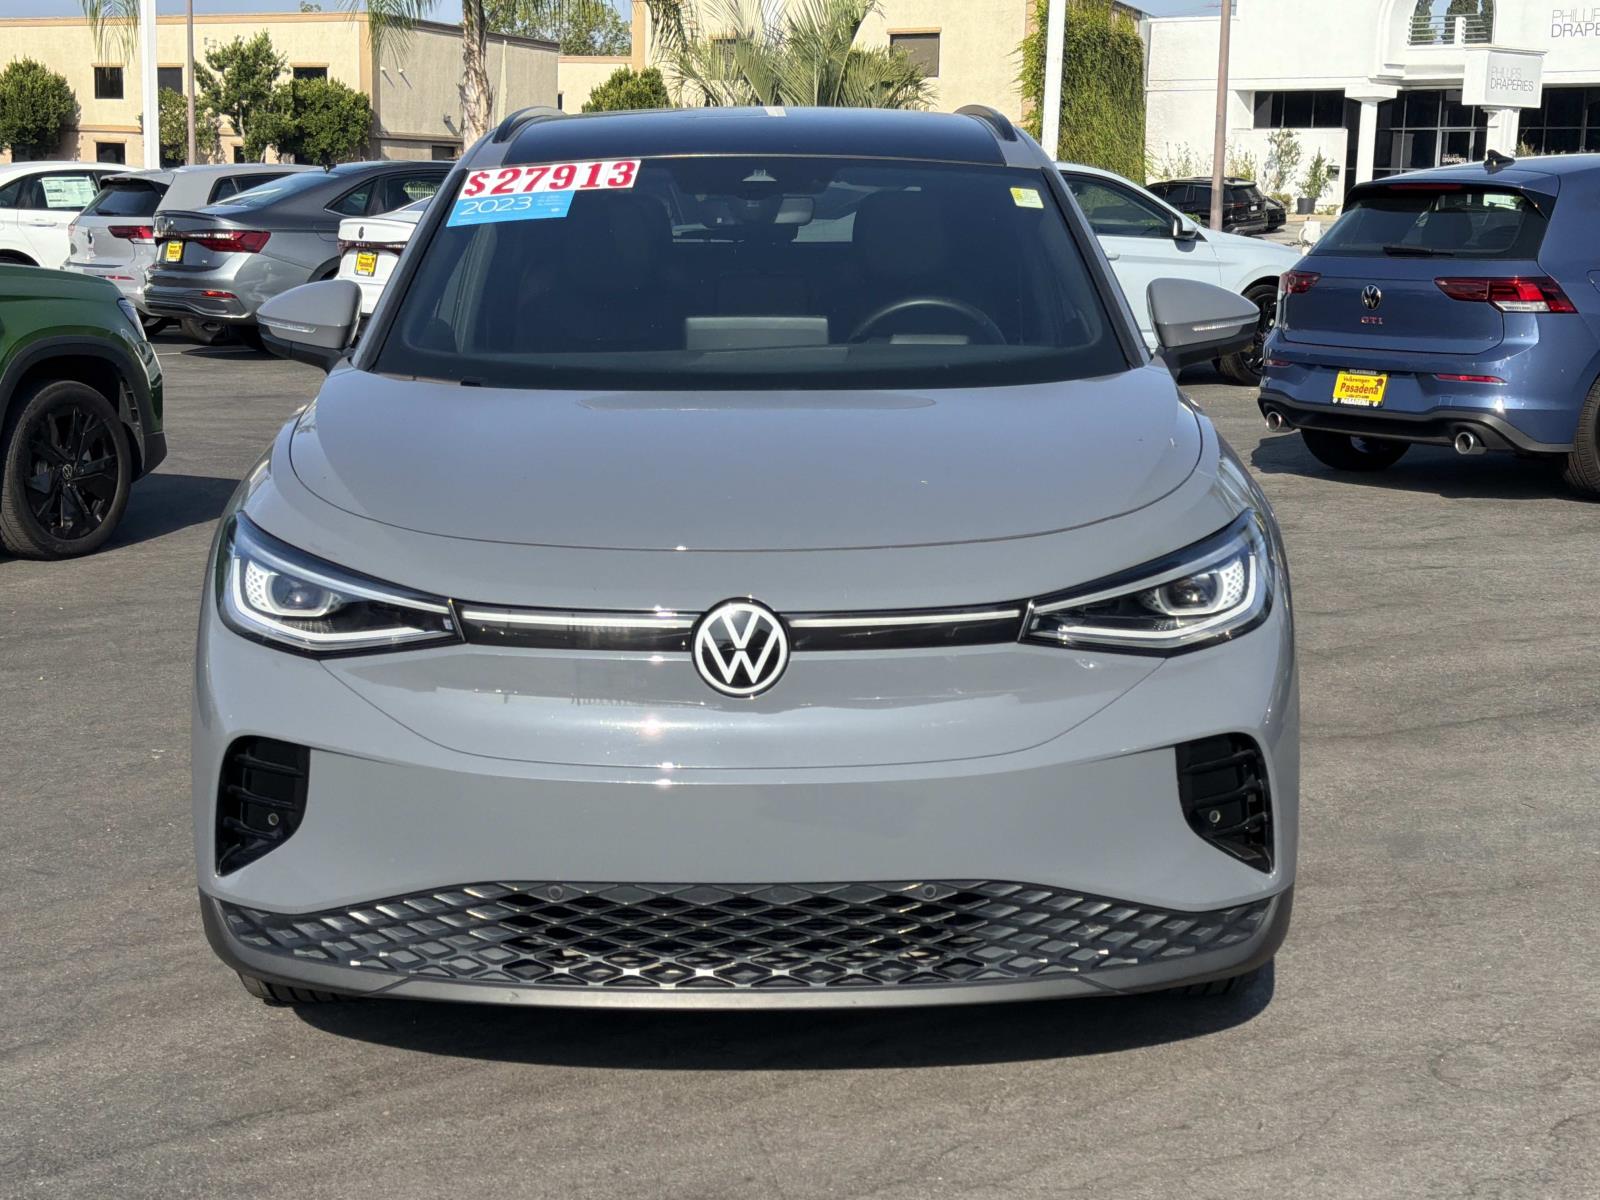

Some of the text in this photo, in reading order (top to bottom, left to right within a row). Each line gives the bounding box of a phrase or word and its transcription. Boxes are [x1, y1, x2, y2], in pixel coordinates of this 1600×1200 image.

[1490, 78, 1534, 92] DRAPERIES
[464, 161, 636, 197] $27913
[460, 196, 532, 215] 2023
[1340, 382, 1379, 395] Pasadena
